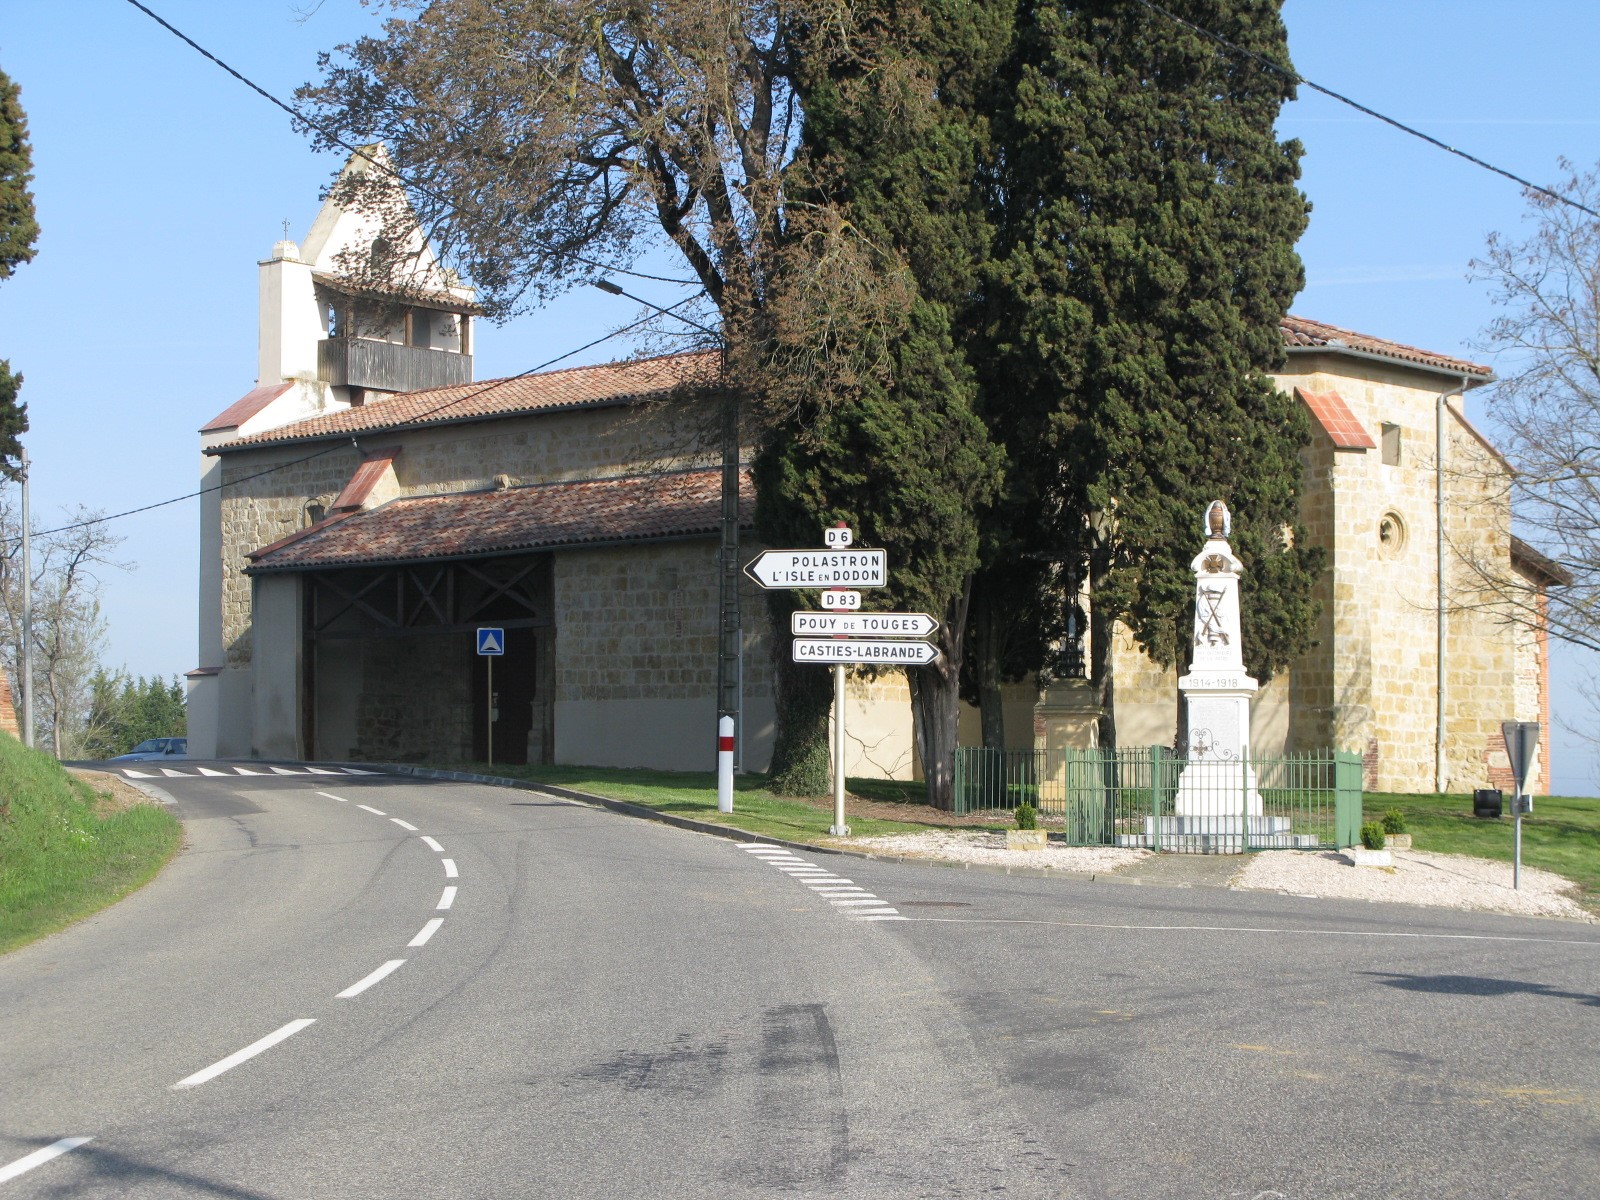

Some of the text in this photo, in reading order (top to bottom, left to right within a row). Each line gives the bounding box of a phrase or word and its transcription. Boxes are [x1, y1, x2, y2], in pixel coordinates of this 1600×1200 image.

[828, 532, 848, 542] D 6
[792, 556, 879, 567] POLASTRON
[833, 570, 879, 581] DODON
[827, 595, 856, 605] D 83
[799, 618, 919, 630] POUY DE TOUGES
[800, 645, 923, 658] CASTIES-LABRANDE
[1189, 678, 1238, 688] 1914-1918
